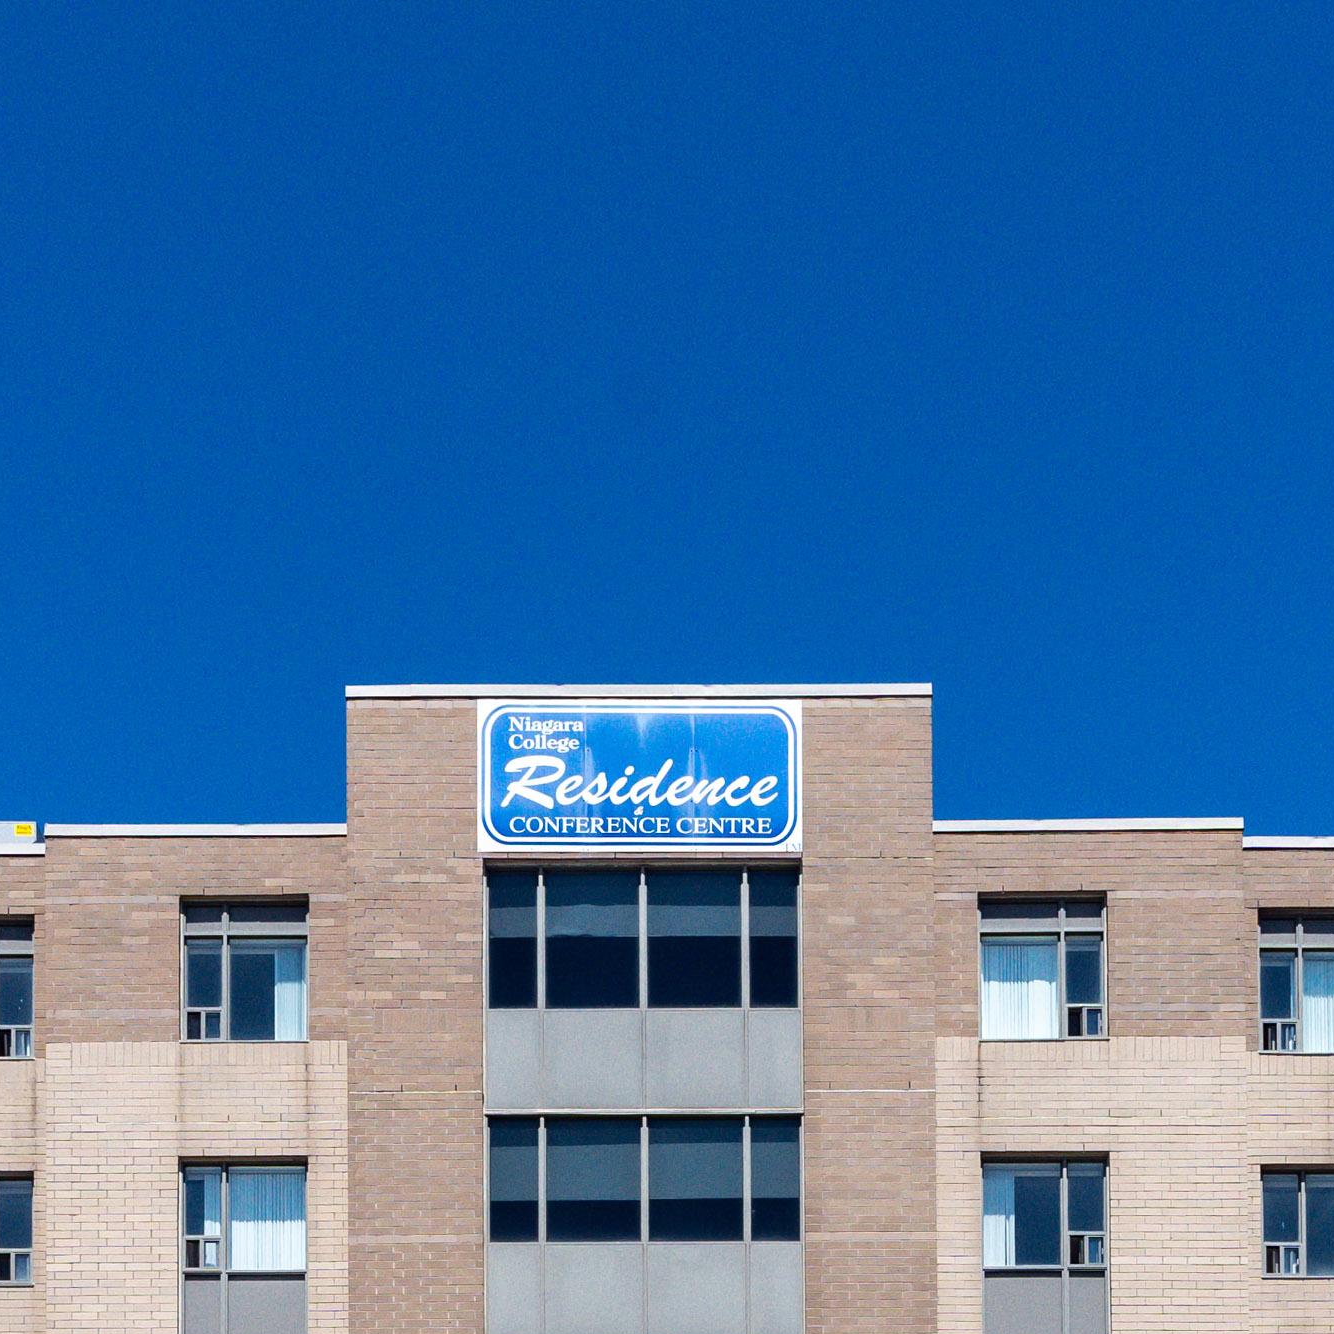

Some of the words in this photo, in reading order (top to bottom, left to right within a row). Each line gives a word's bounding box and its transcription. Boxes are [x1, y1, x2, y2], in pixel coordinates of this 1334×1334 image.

[508, 716, 585, 735] Niagara
[508, 734, 580, 754] College
[501, 756, 778, 809] Residence
[633, 806, 644, 817] &
[509, 816, 671, 834] CONFERENCE
[676, 817, 772, 834] CENTRE
